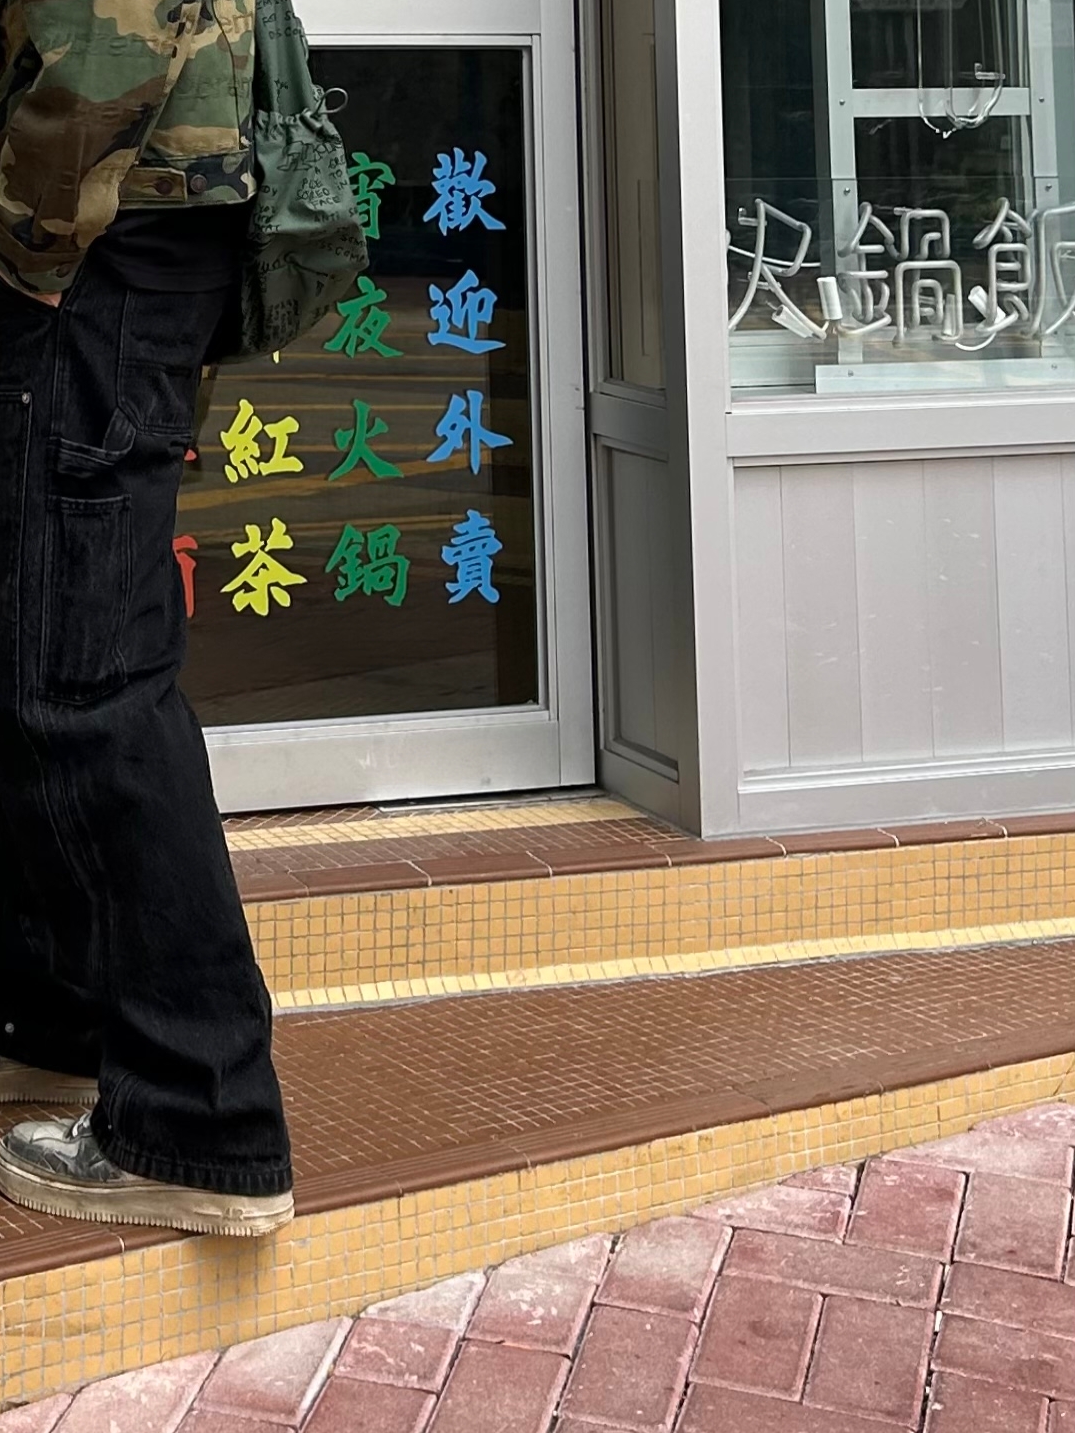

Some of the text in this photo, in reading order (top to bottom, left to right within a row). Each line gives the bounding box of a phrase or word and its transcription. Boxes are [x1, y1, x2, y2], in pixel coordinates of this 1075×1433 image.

[219, 350, 308, 617] 紅茶
[324, 152, 410, 608] 宵夜火鍋
[422, 146, 514, 606] 歡迎外賣
